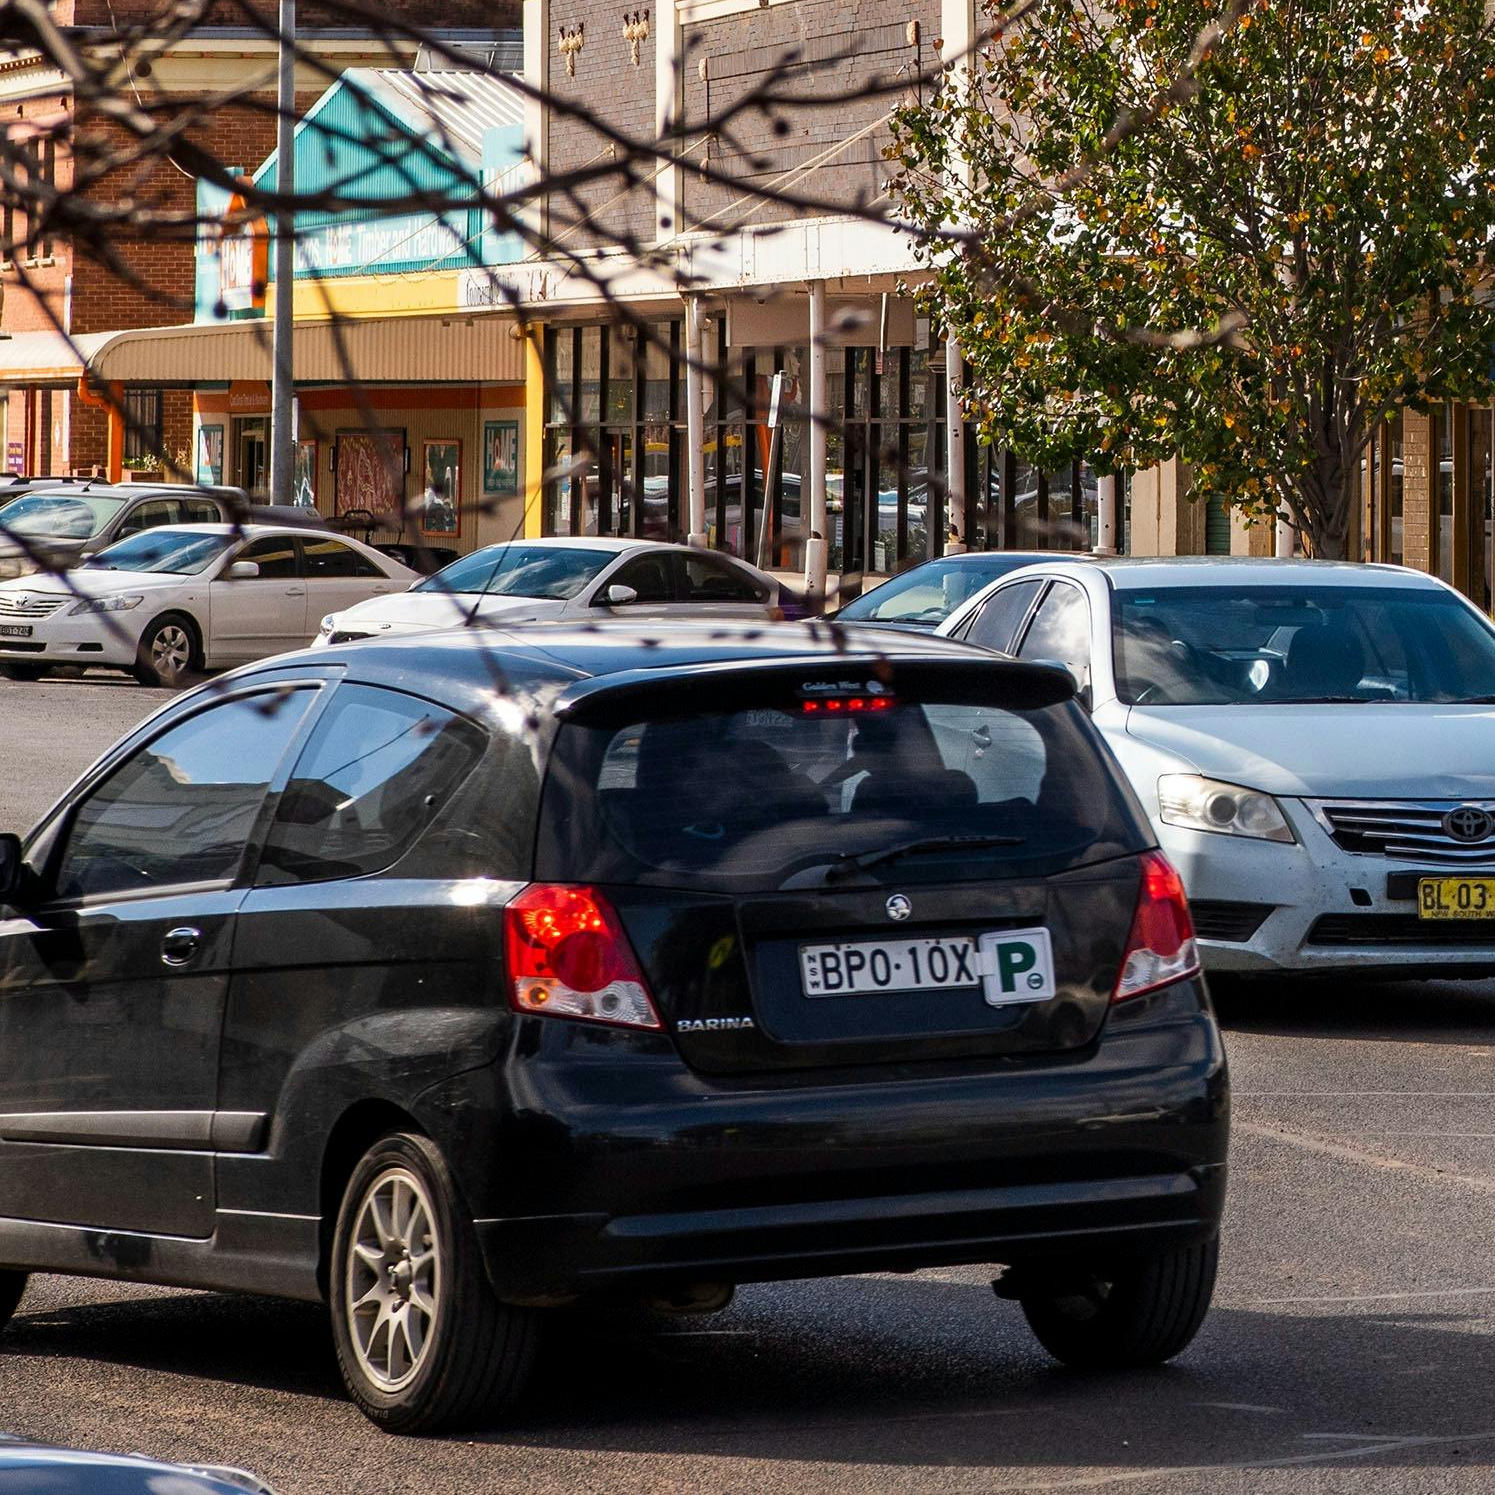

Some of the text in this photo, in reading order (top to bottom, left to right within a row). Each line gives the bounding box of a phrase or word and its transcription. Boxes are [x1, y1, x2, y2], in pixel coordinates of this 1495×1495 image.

[1431, 910, 1448, 918] NEW
[1453, 910, 1481, 918] SOUTH
[995, 940, 1037, 993] P
[677, 1016, 755, 1032] BARINA
